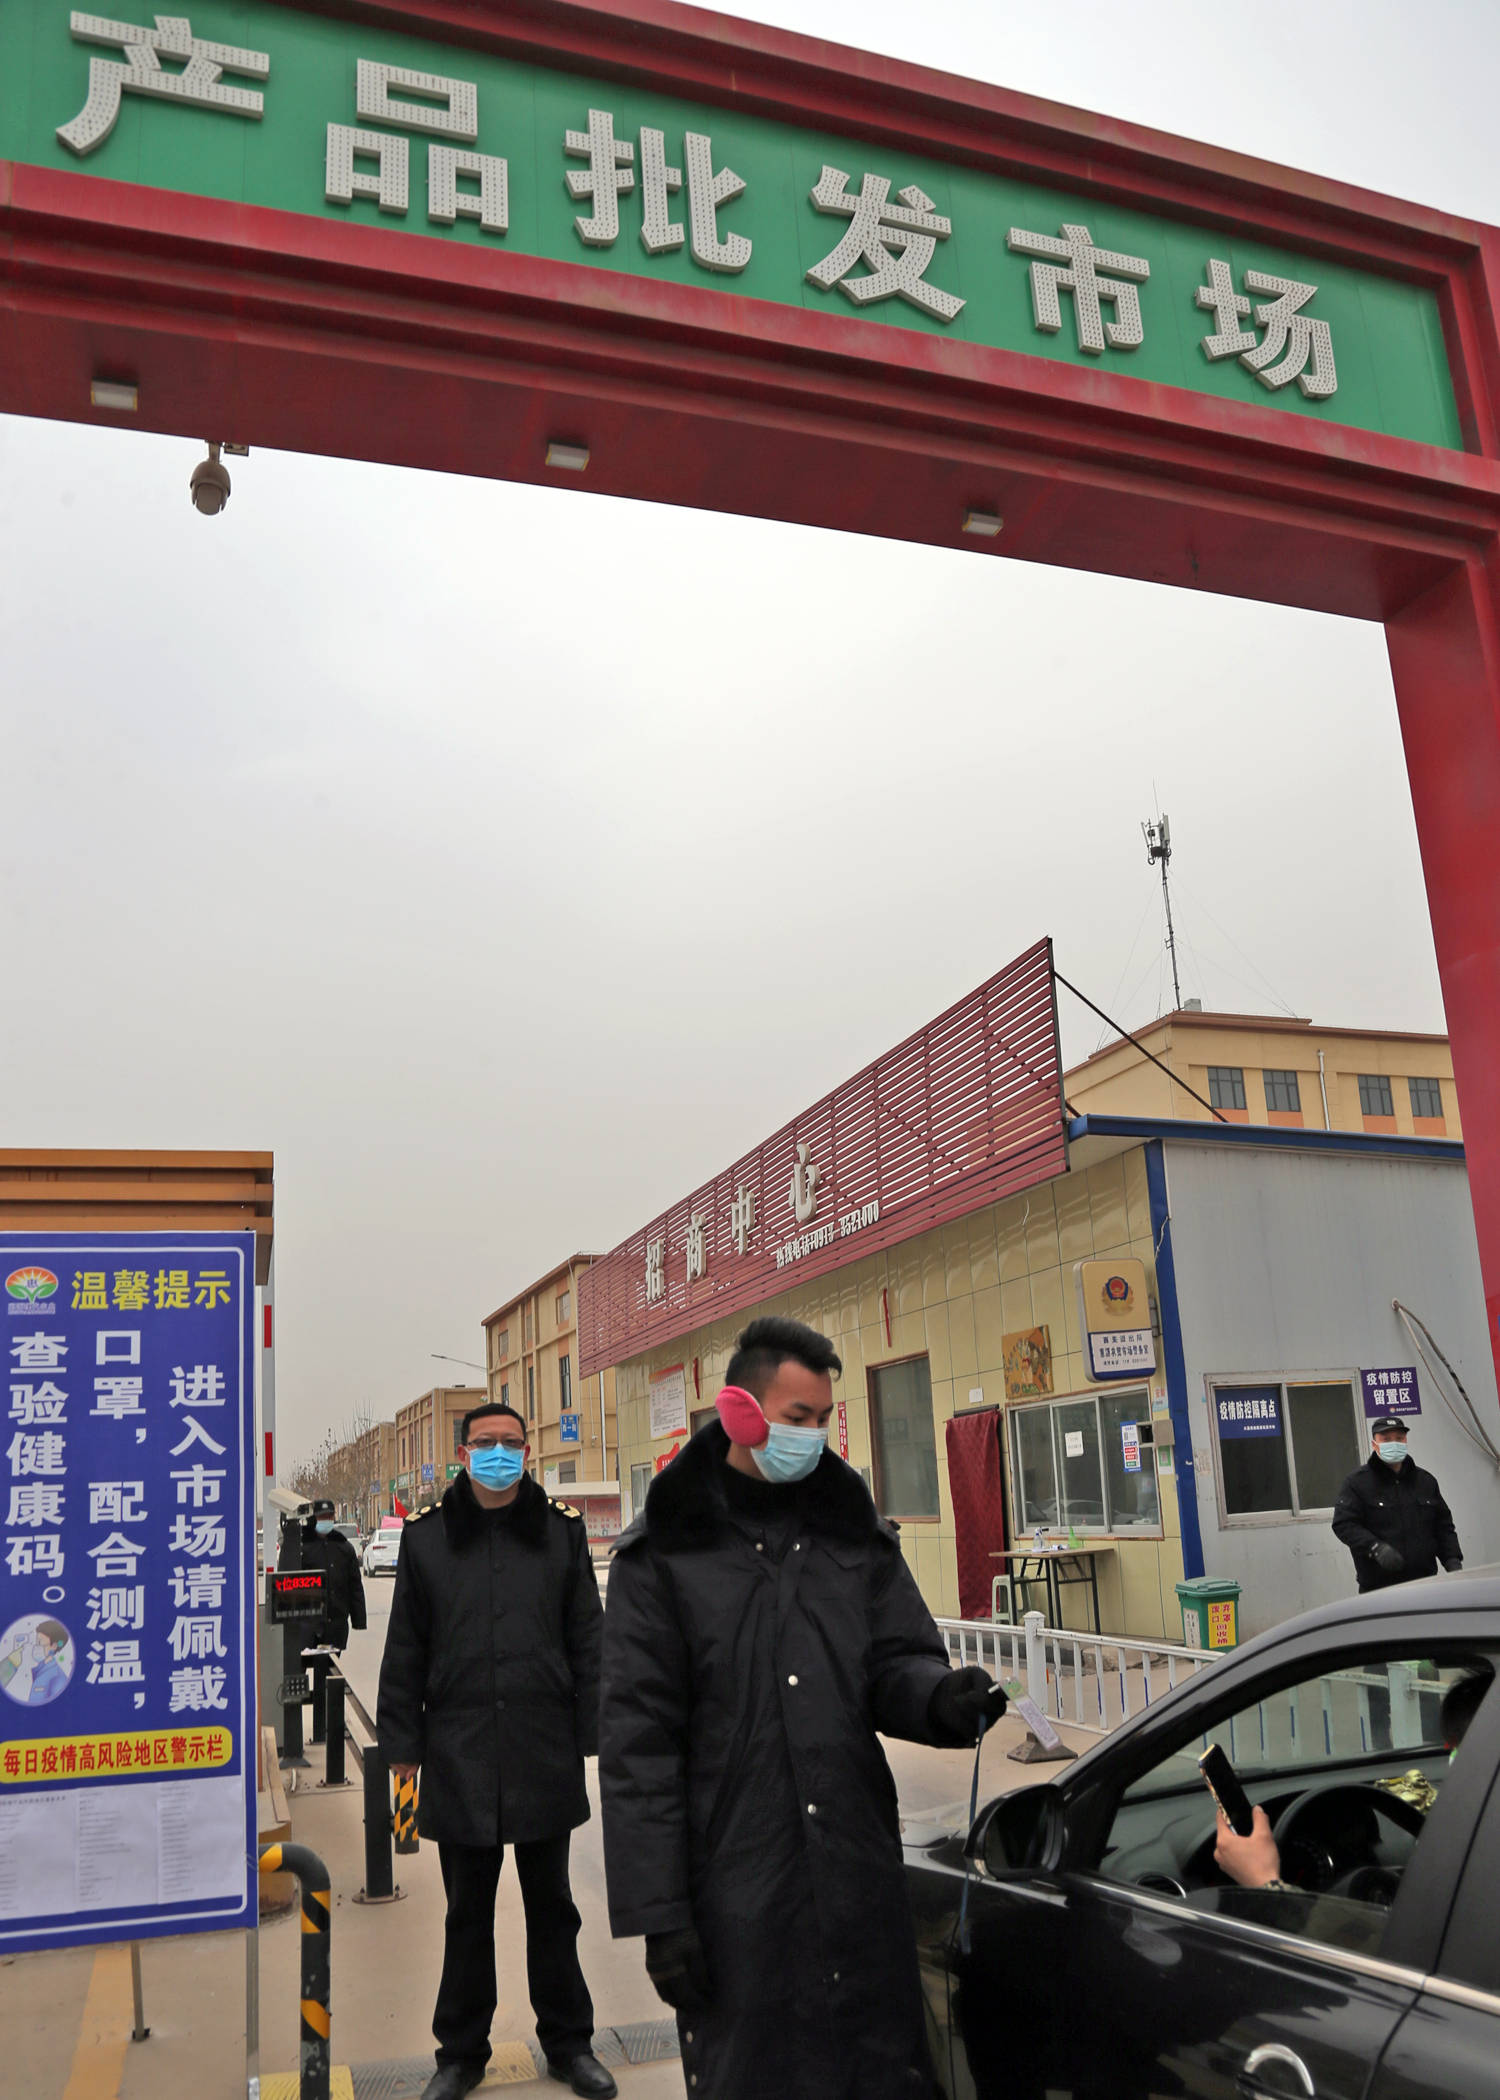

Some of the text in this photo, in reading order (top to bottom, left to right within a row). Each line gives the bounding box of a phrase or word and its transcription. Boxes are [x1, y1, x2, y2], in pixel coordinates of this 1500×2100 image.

[57, 10, 1339, 398] 产品批发市场
[71, 1269, 231, 1311] 温馨提示
[1366, 1371, 1413, 1386] 疫情防控
[1373, 1387, 1411, 1405] 留置区
[1219, 1399, 1276, 1420] 疫情防控隔离点
[168, 1364, 228, 1713] 进入市场请佩戴
[4, 1734, 224, 1777] 每日疫情高风险地区警示栏
